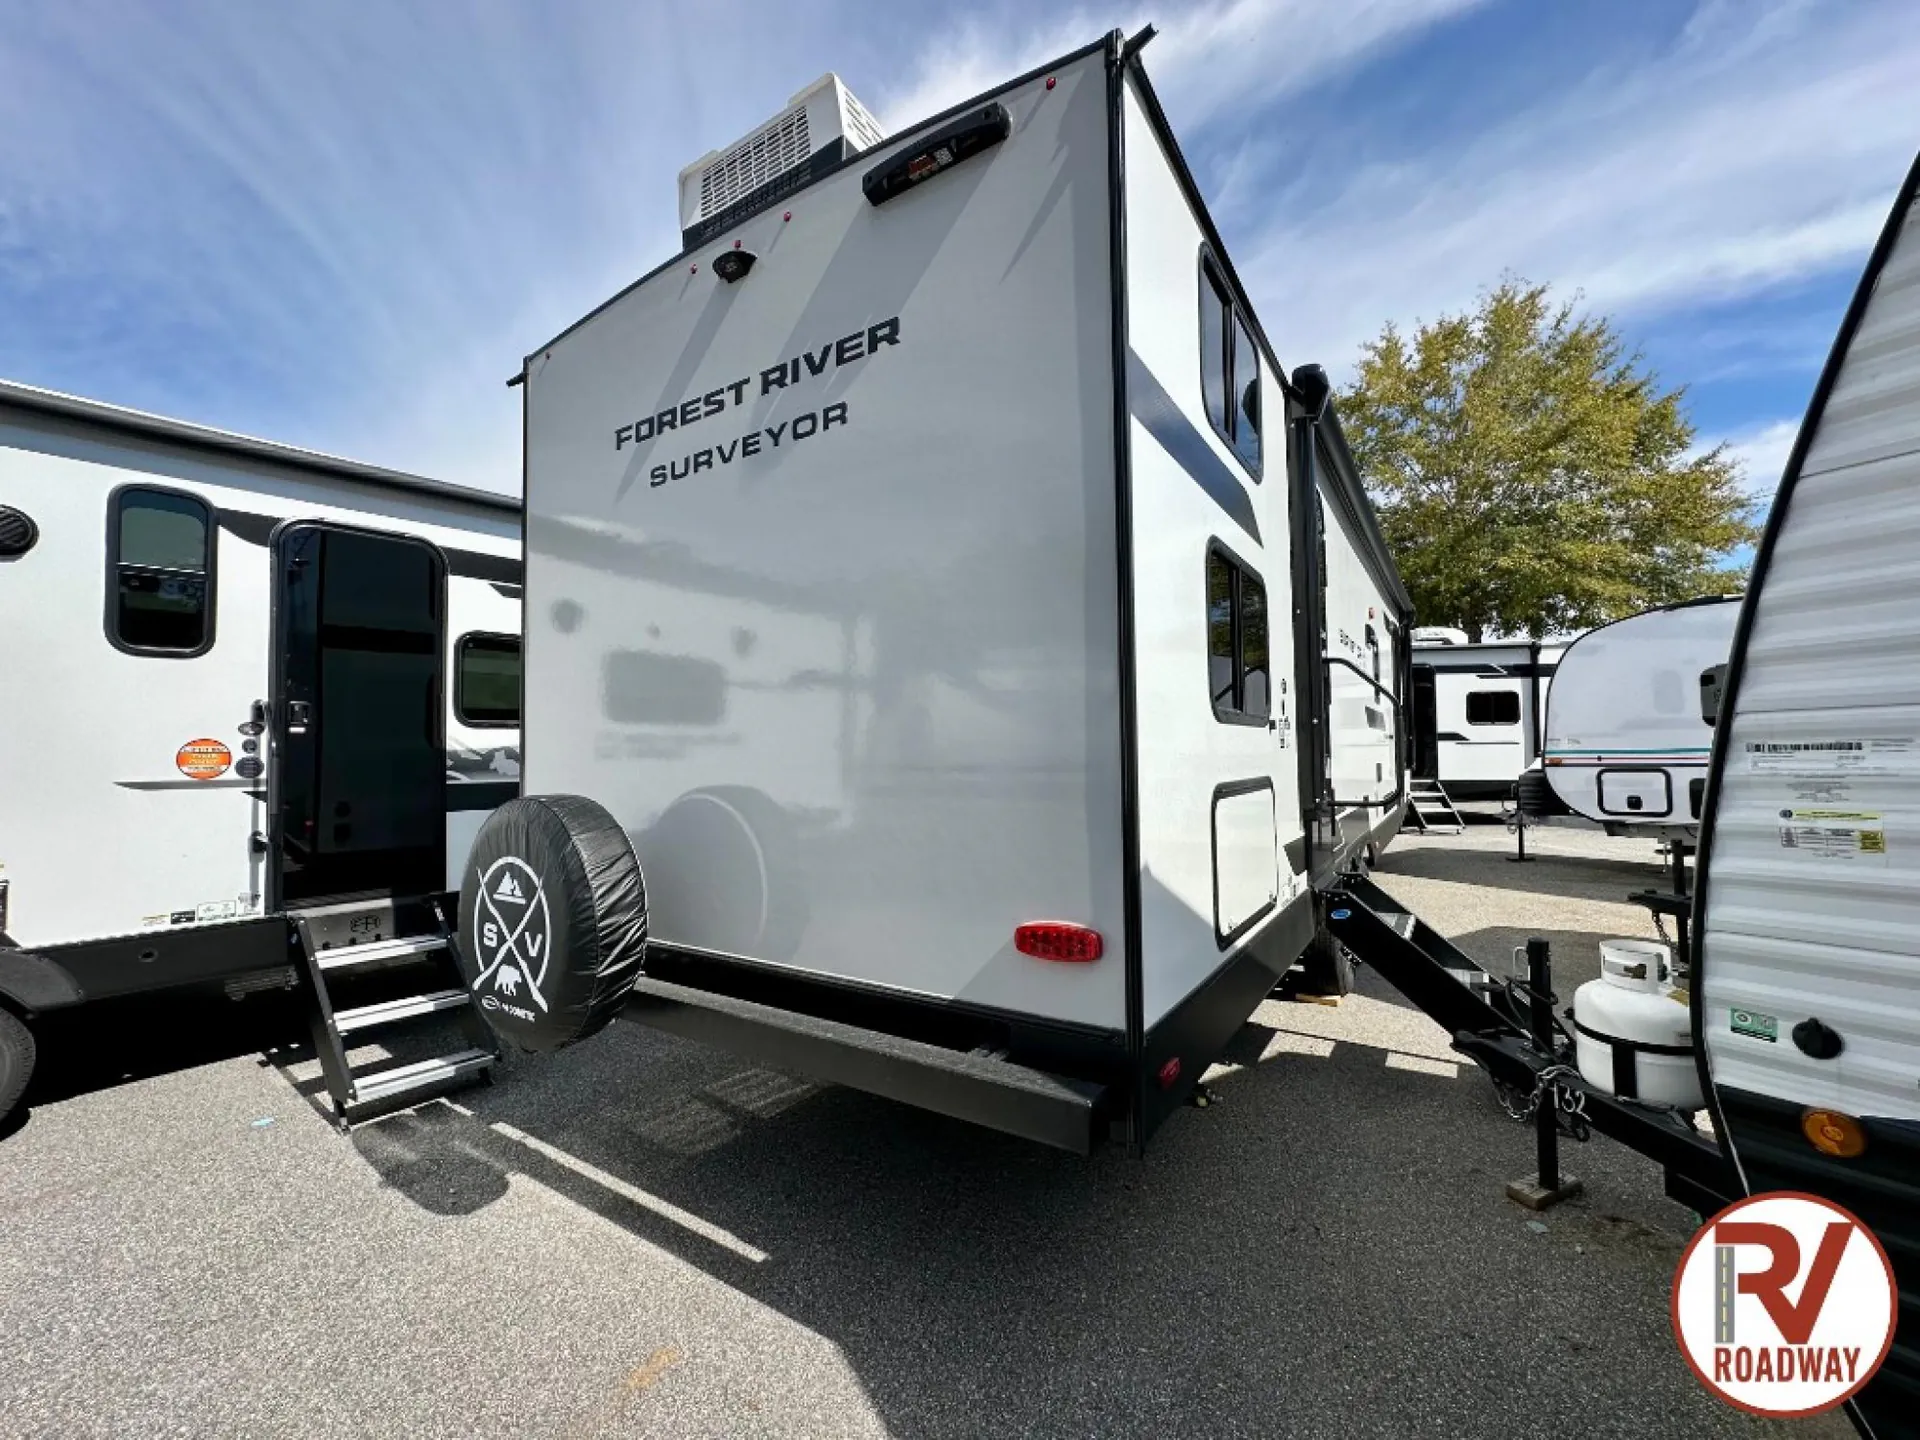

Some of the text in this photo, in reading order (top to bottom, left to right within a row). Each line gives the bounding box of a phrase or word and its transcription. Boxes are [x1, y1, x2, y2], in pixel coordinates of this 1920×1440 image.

[614, 316, 901, 451] FOREST RIVER
[650, 401, 848, 488] SURVEYOR
